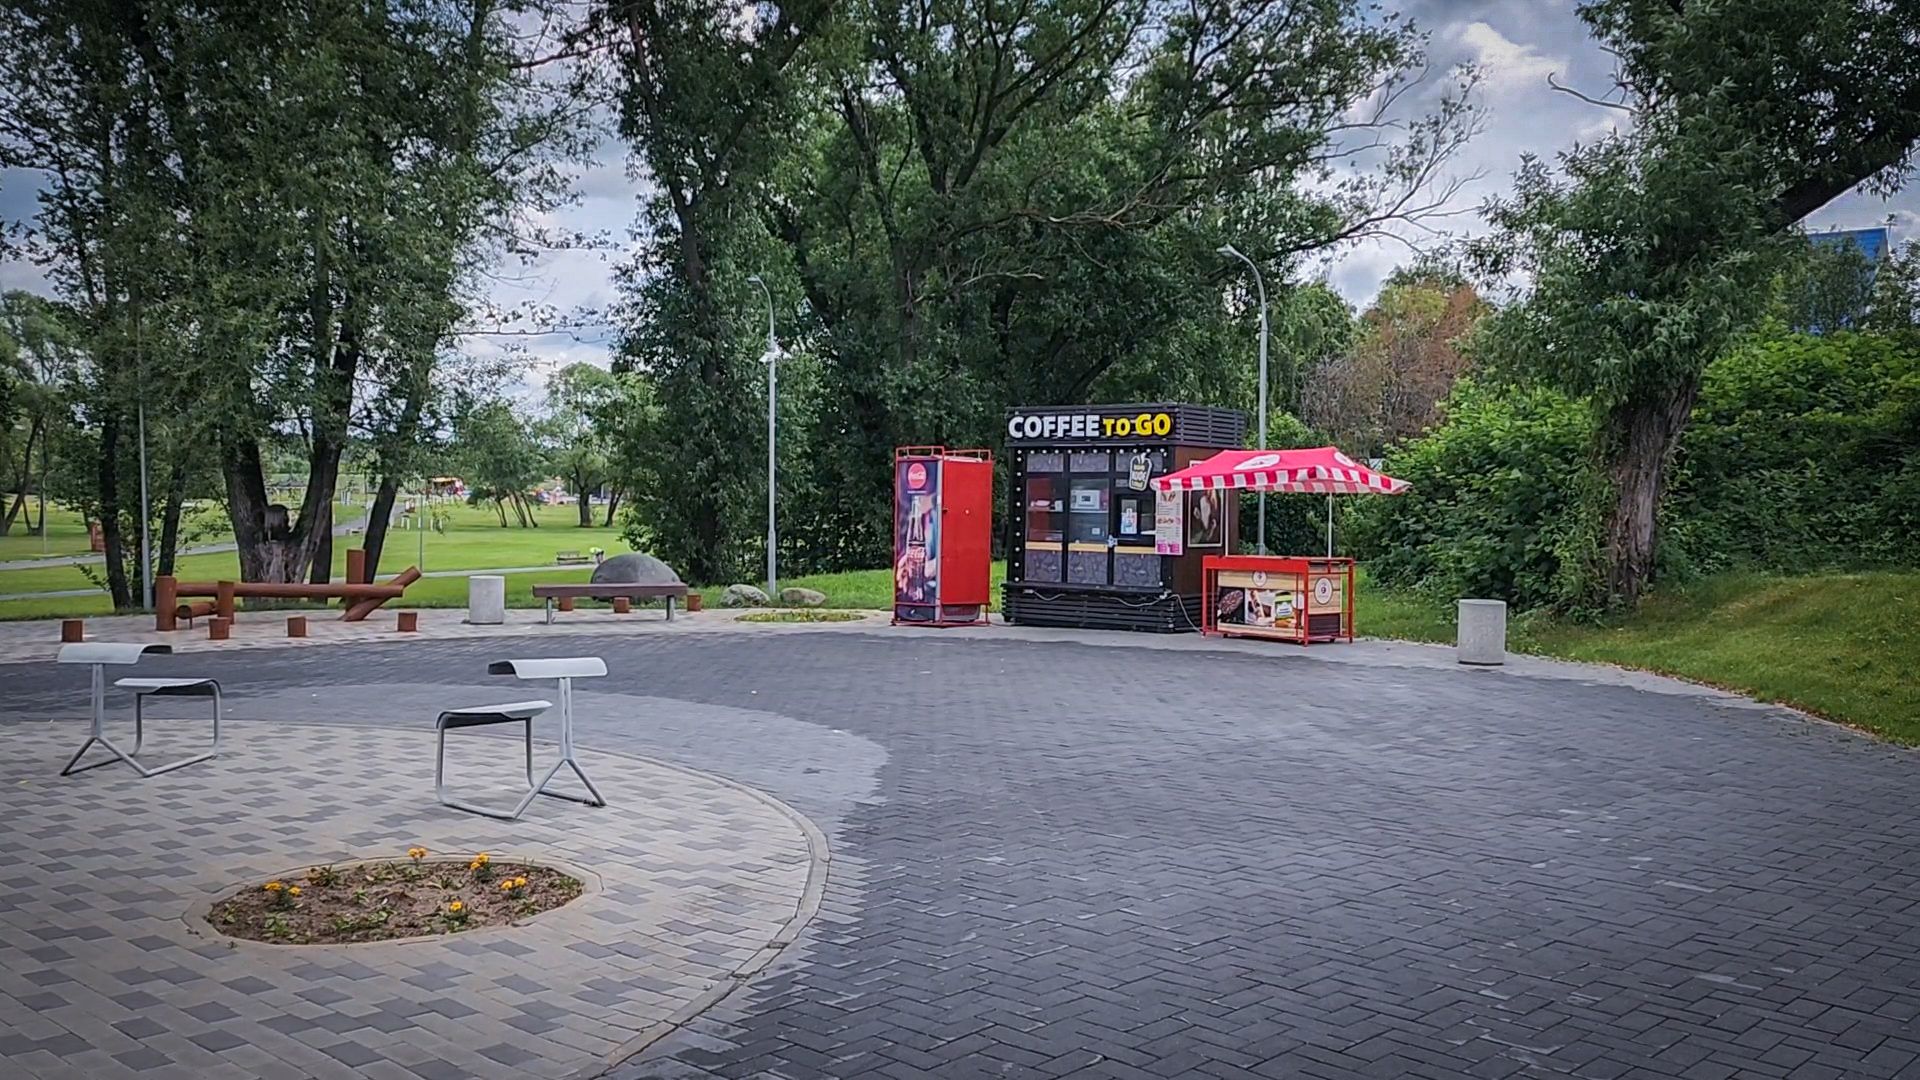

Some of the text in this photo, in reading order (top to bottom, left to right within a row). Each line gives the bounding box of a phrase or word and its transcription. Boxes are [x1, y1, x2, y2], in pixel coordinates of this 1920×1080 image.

[1008, 413, 1171, 438] COFFEE TO GO
